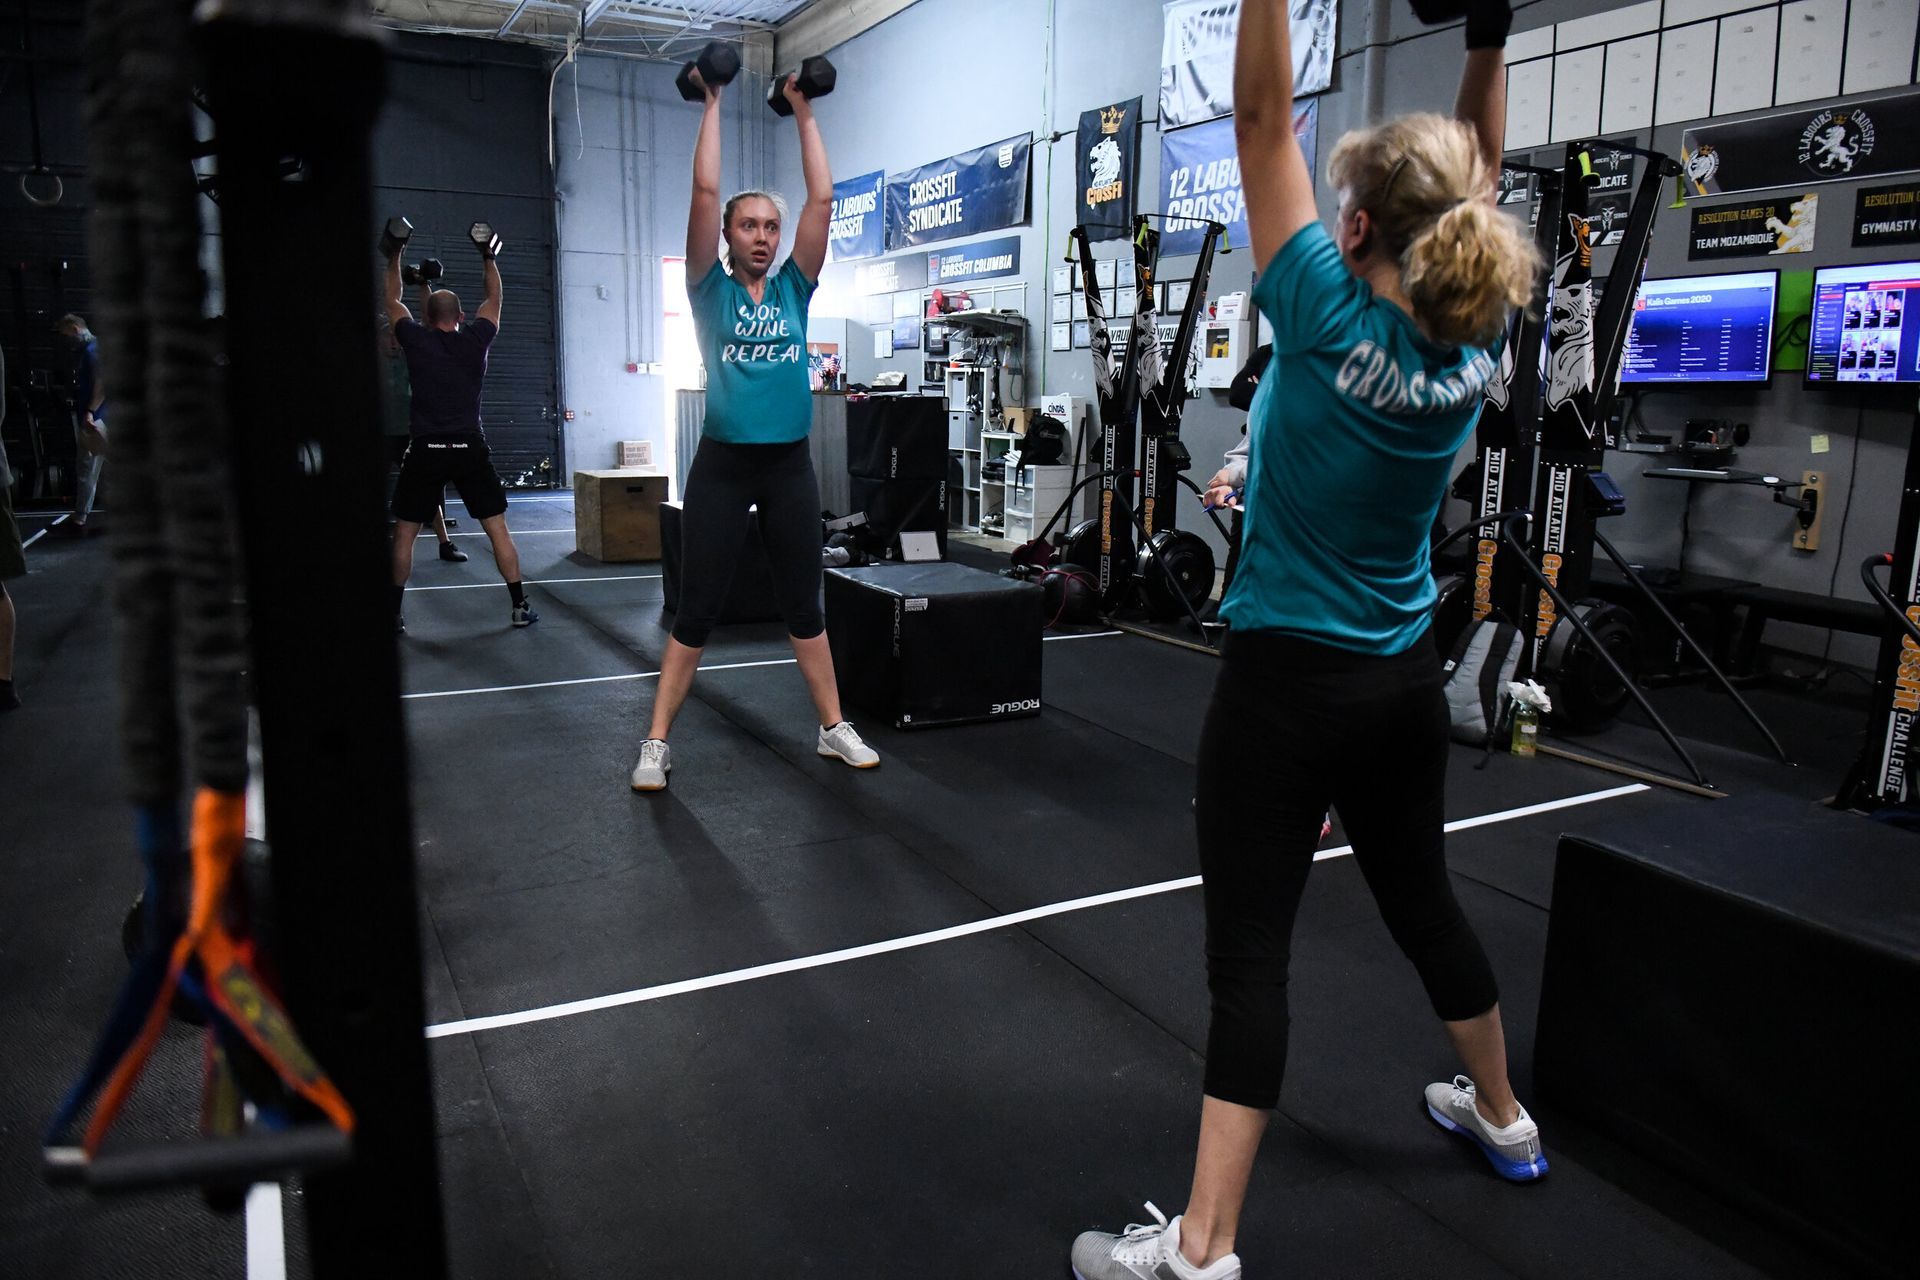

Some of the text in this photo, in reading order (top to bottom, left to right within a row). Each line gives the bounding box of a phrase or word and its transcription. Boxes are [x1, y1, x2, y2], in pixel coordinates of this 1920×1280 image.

[1798, 110, 1833, 150] LABOURS
[1851, 109, 1875, 156] CROSSFIT
[909, 170, 958, 207] CROSSFIT
[1169, 156, 1240, 199] 12 LABO
[830, 190, 877, 221] 2 LABOURS
[909, 198, 963, 233] SYNDICATE
[1165, 188, 1247, 233] CROSSF
[1698, 210, 1739, 224] RESOLUTION
[1740, 207, 1765, 220] GAMES
[1864, 191, 1914, 207] RESOLUTION
[1696, 232, 1774, 249] TEAM MOZAMBIQUE
[1861, 219, 1917, 235] GYMNASTY
[940, 260, 974, 278] CROSSFIT
[973, 254, 1013, 274] COLUMBIA
[1690, 294, 1712, 304] 2020
[734, 319, 790, 338] WINE
[722, 343, 801, 364] REPEAT
[1104, 445, 1112, 490] ATLATIC
[1146, 457, 1154, 497] ATLANTIC
[1483, 451, 1501, 538] MID ATLAIC
[1549, 471, 1566, 553] MID ATLANTIC
[1473, 539, 1498, 621] CrossFi
[991, 698, 1040, 714] ROGUE
[1885, 712, 1912, 793] CHALLENGE
